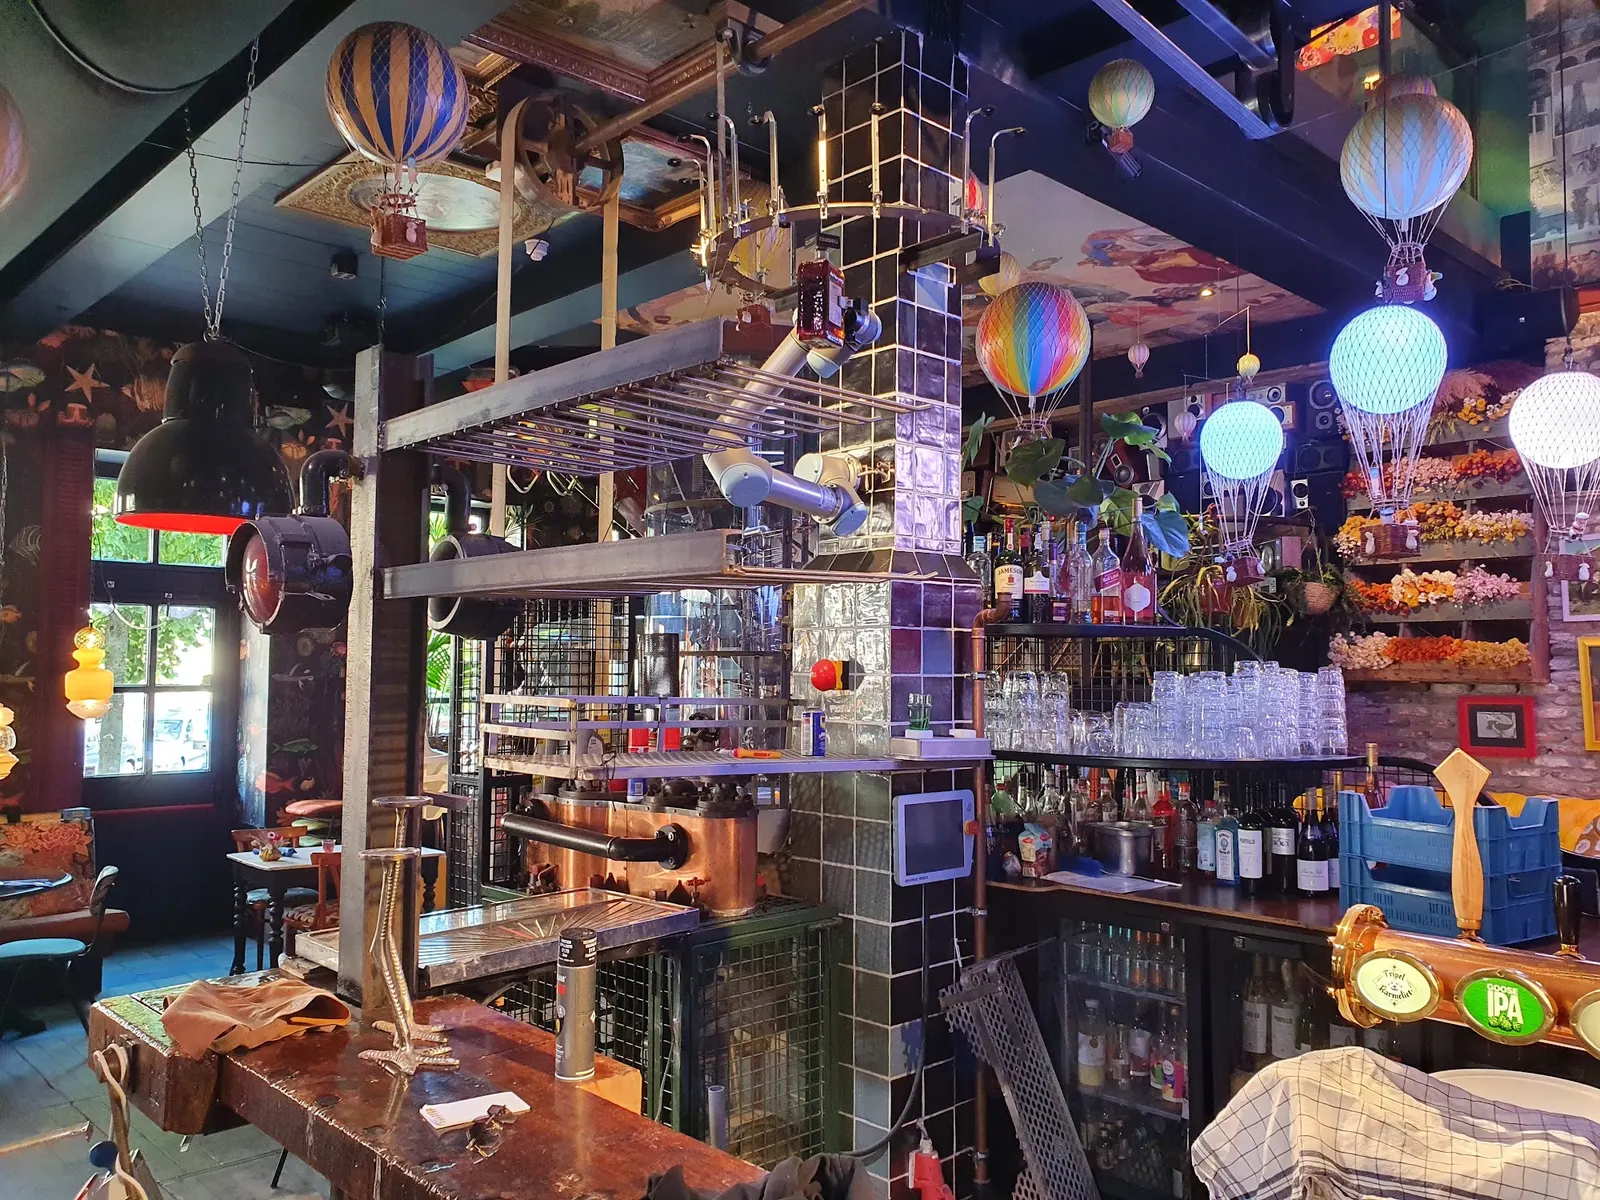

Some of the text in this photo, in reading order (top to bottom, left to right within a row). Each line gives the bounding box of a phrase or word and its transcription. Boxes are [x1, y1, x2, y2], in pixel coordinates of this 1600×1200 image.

[1383, 969, 1406, 981] Tripel
[1379, 984, 1413, 1000] Karmeliet
[1487, 983, 1519, 995] GOOSE
[1487, 990, 1524, 1025] IPA
